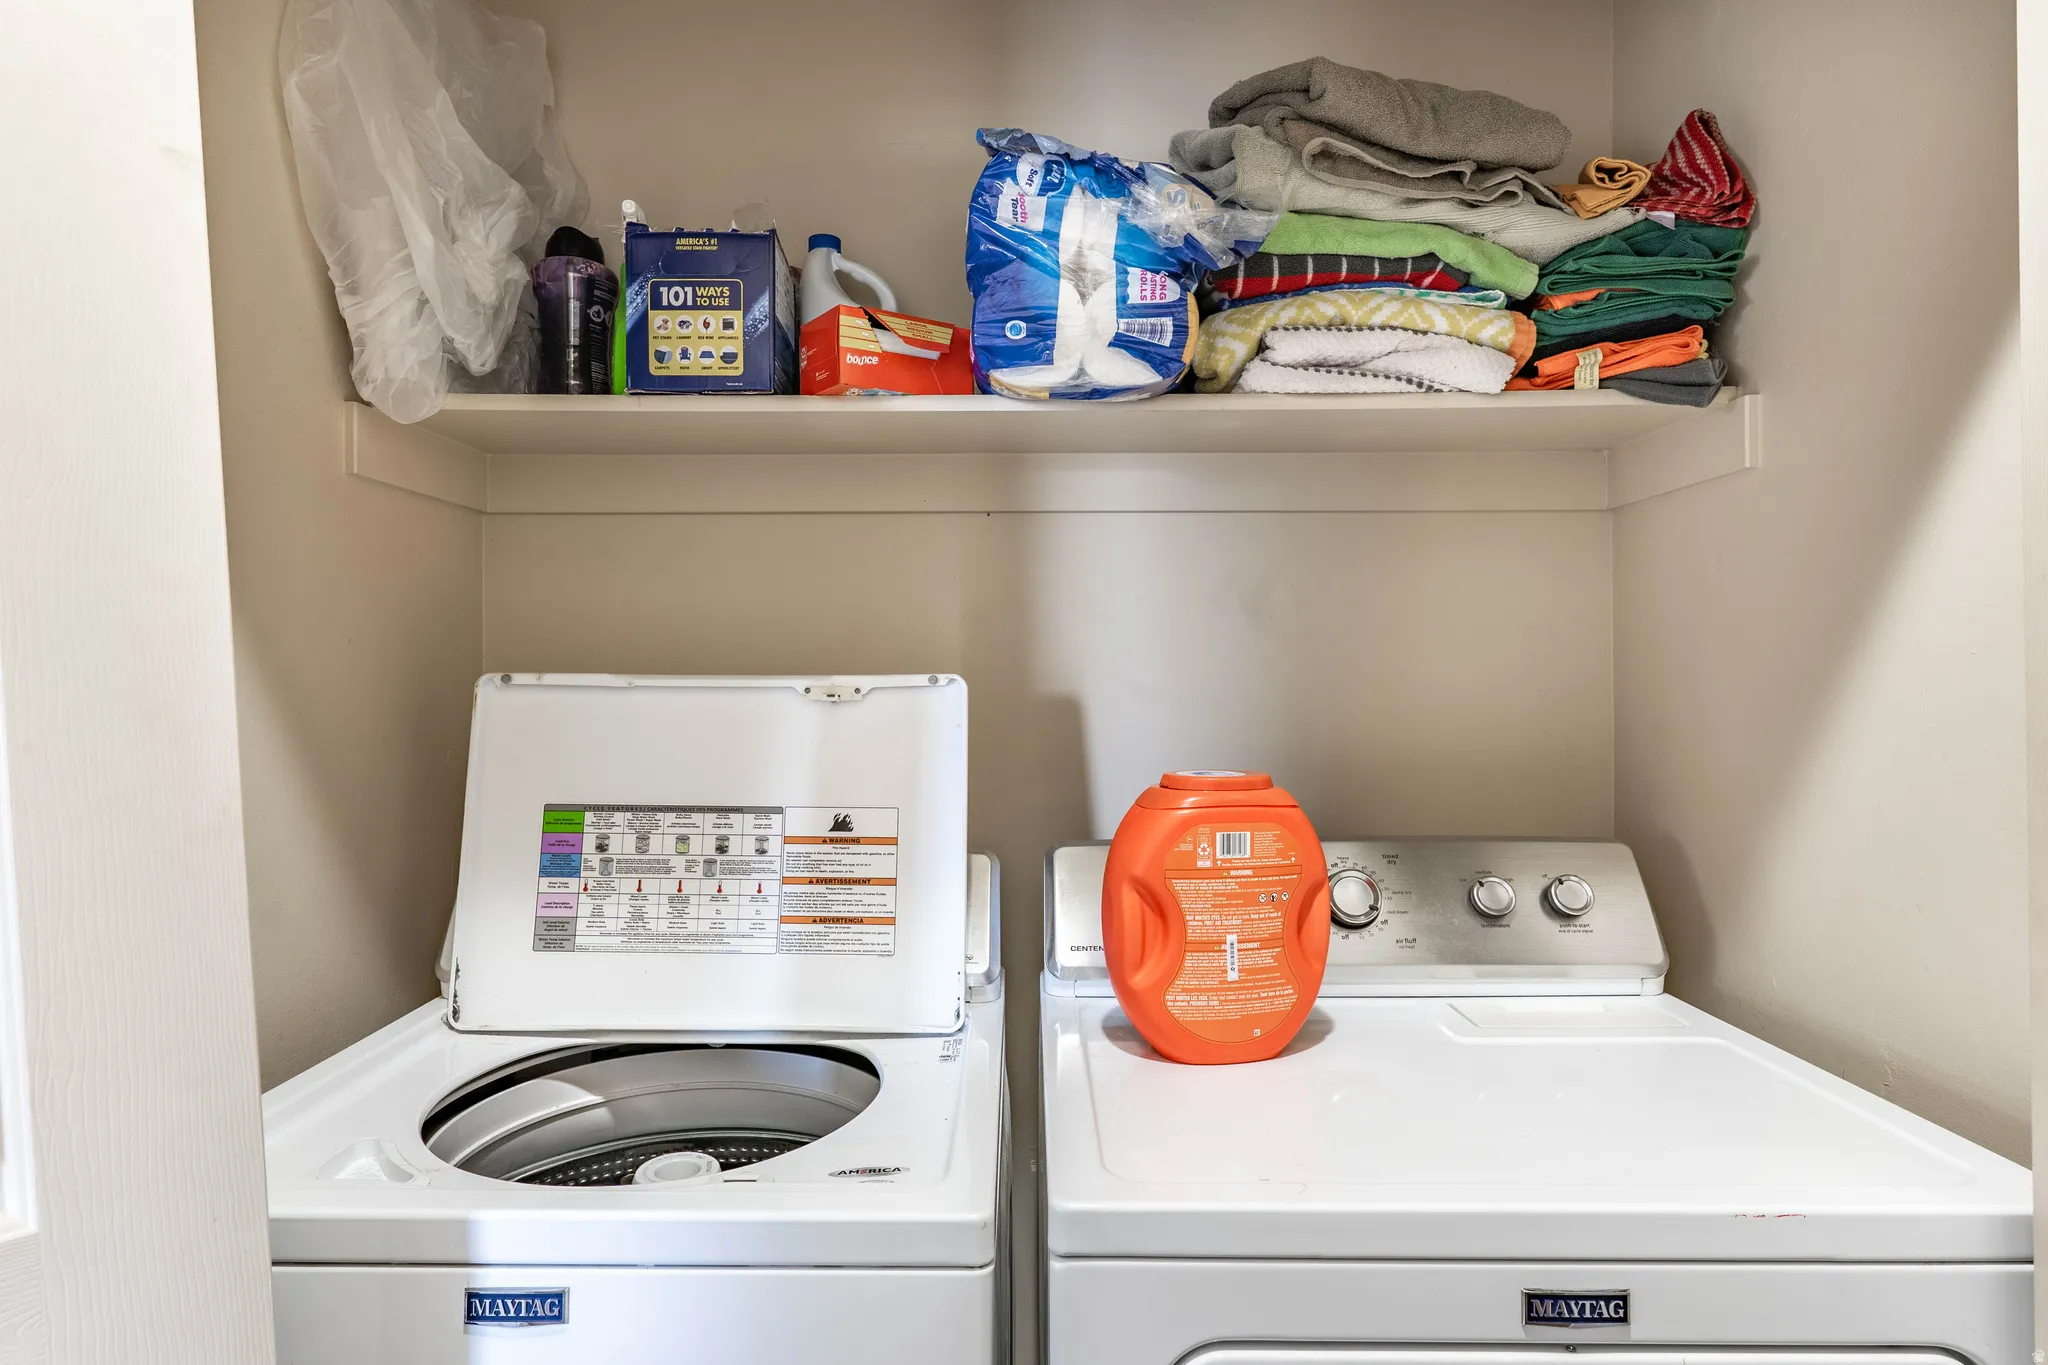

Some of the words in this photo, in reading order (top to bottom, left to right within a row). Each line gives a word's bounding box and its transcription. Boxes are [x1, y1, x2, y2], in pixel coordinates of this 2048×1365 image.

[1025, 168, 1039, 188] Soft
[1010, 197, 1019, 223] Tear
[675, 237, 709, 246] AMERICA'S
[710, 237, 718, 246] #1
[695, 286, 730, 297] WAYS
[1139, 269, 1148, 302] ROLLS
[659, 286, 693, 307] 101
[696, 298, 710, 306] TO
[711, 298, 730, 306] USE
[846, 352, 880, 367] bounce
[837, 1167, 902, 1175] AMERICA
[469, 1298, 560, 1317] MAYTAG
[1530, 1299, 1625, 1318] MAYTAG
